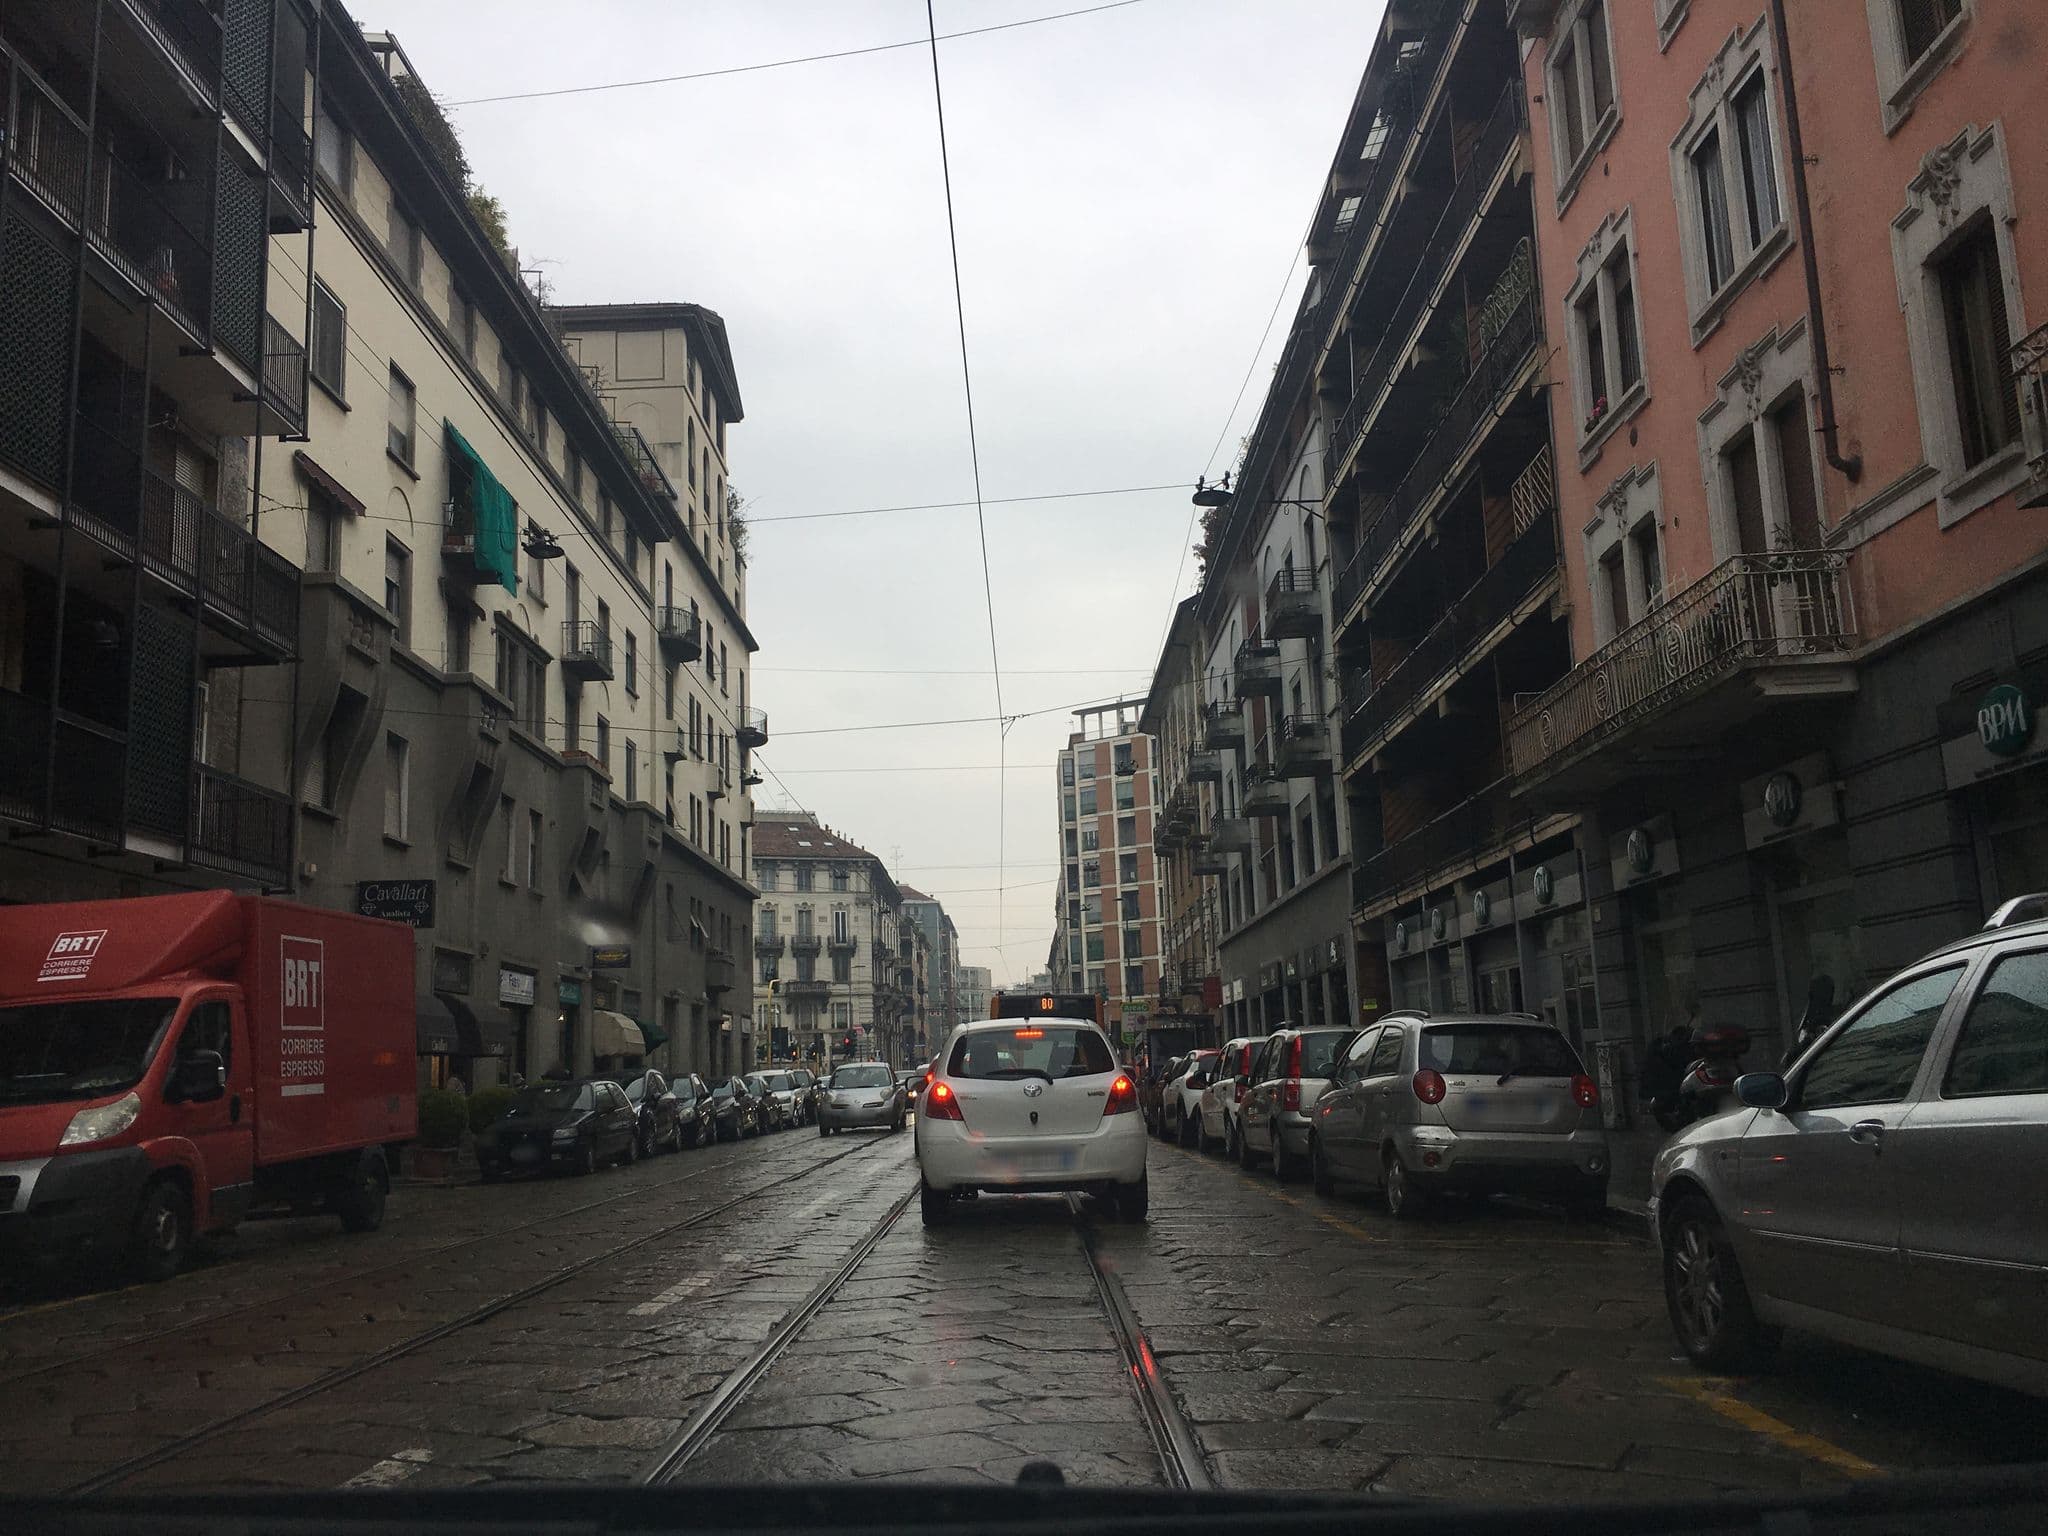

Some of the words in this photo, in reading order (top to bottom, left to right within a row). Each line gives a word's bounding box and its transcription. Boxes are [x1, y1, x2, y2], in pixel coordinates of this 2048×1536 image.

[1978, 695, 2027, 745] BPM
[364, 883, 428, 902] Cavallari
[54, 935, 99, 953] BRT
[40, 965, 89, 976] ESPRESSO
[43, 958, 92, 969] CORRIERE
[285, 958, 320, 1008] BRT
[1041, 998, 1053, 1010] 80
[281, 1038, 325, 1055] CORRIERE
[281, 1060, 325, 1077] ESPRESSO
